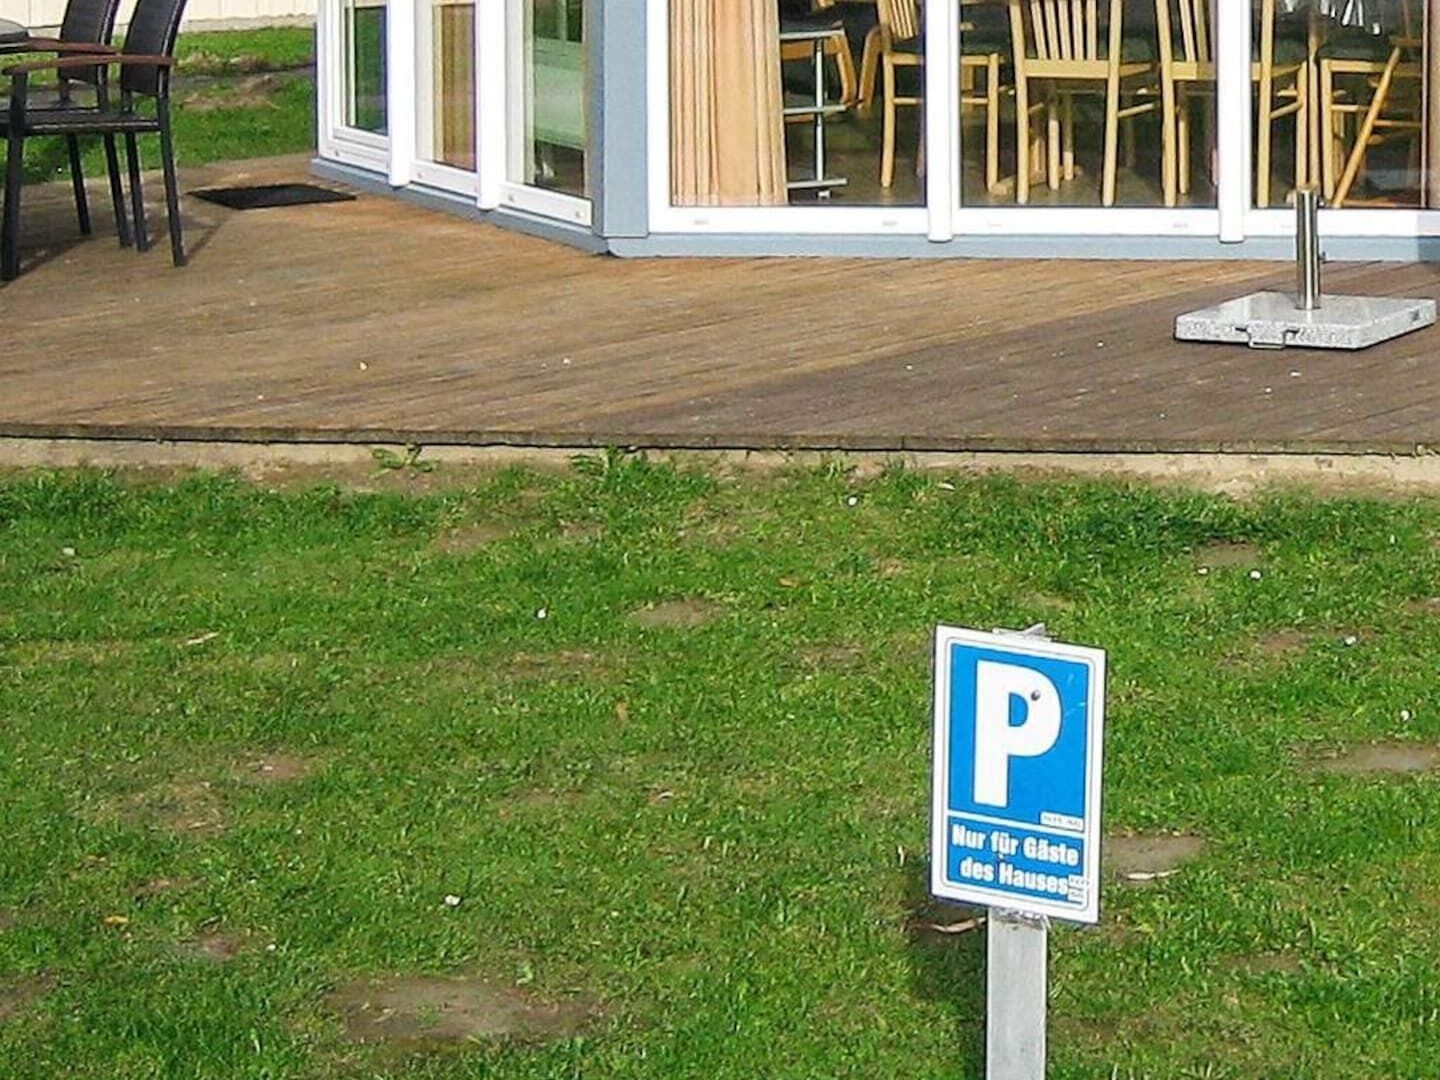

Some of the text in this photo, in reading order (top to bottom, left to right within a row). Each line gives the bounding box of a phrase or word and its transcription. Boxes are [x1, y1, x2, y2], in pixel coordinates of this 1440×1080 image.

[973, 659, 1062, 808] P
[952, 823, 1079, 866] Nur für Gäste
[960, 856, 994, 882] des
[998, 861, 1068, 895] Hauses
